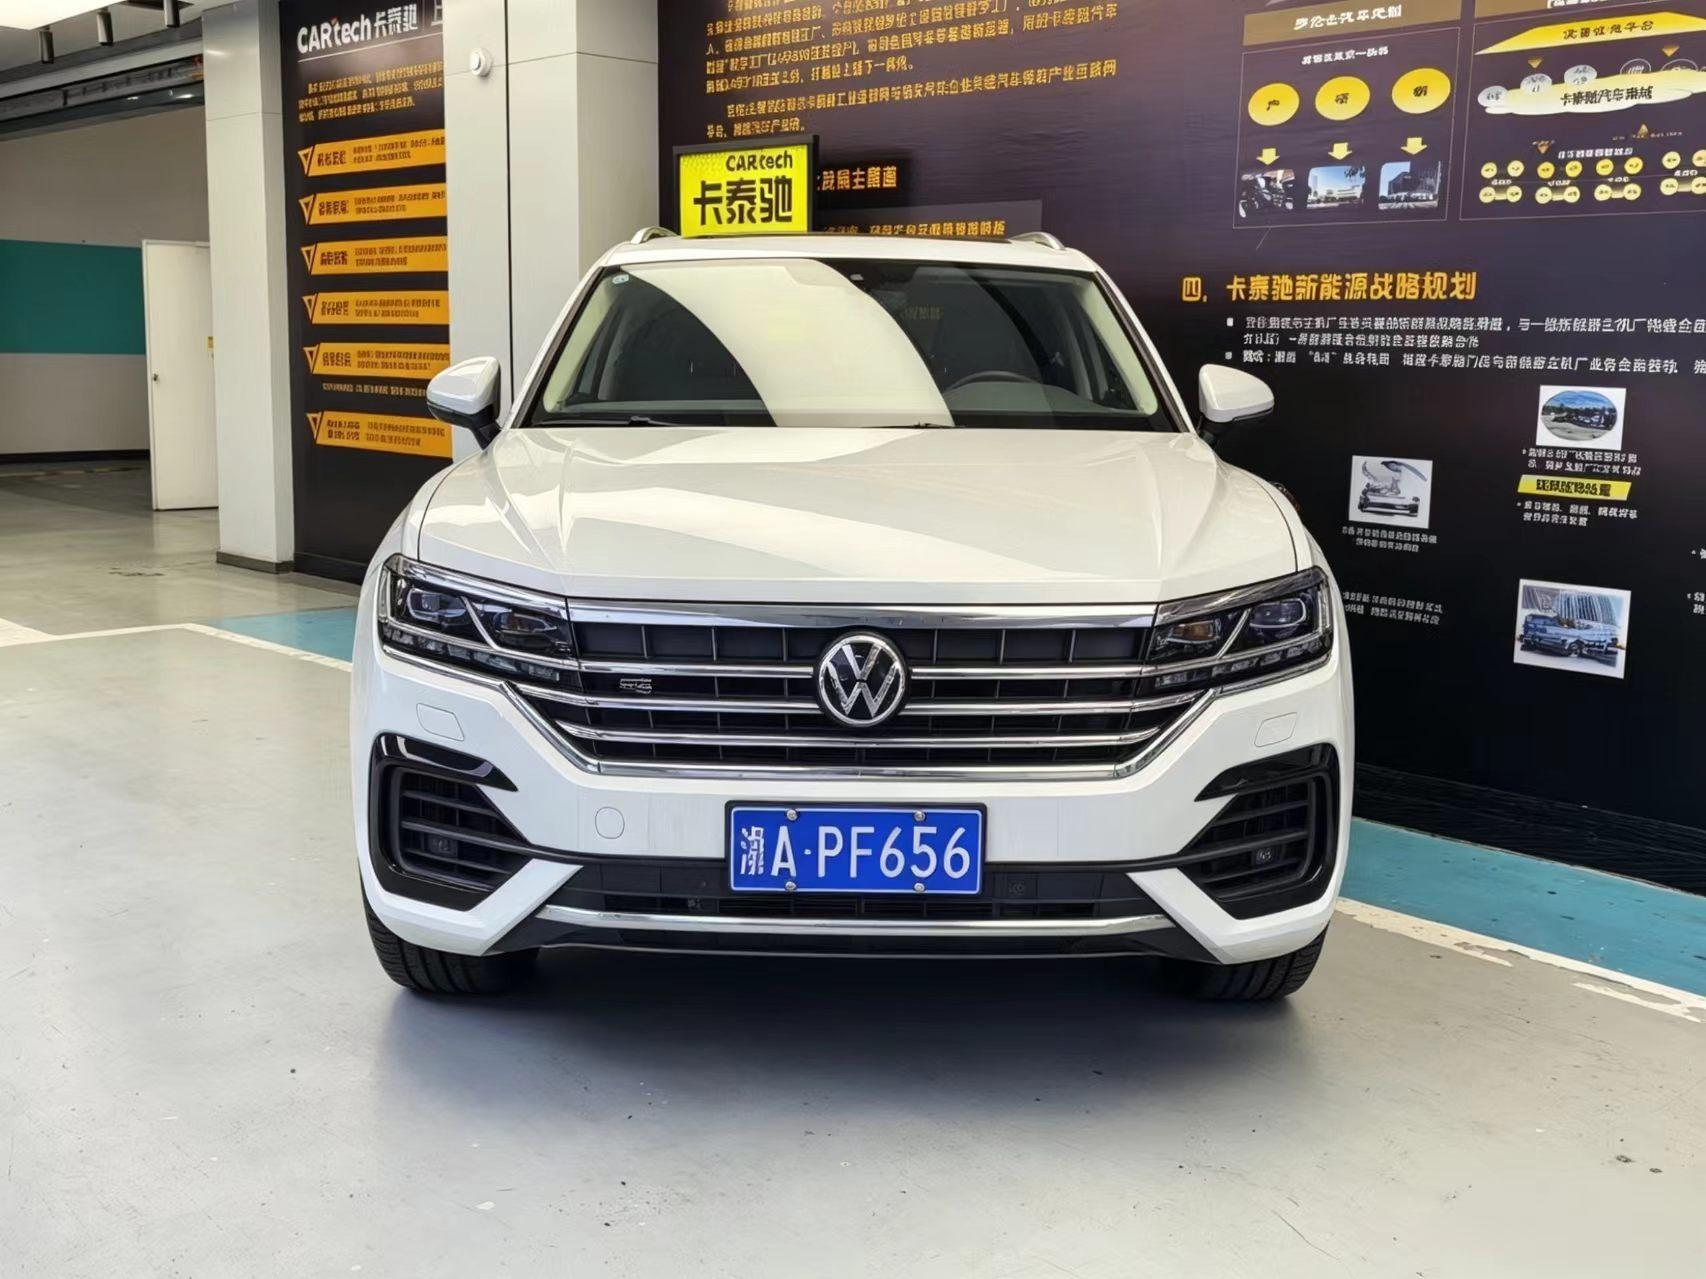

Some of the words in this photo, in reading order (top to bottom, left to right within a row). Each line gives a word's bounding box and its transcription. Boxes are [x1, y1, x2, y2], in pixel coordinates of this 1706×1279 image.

[297, 14, 372, 54] CARtech
[726, 150, 793, 172] CARtech
[693, 175, 793, 226] 卡泰驰
